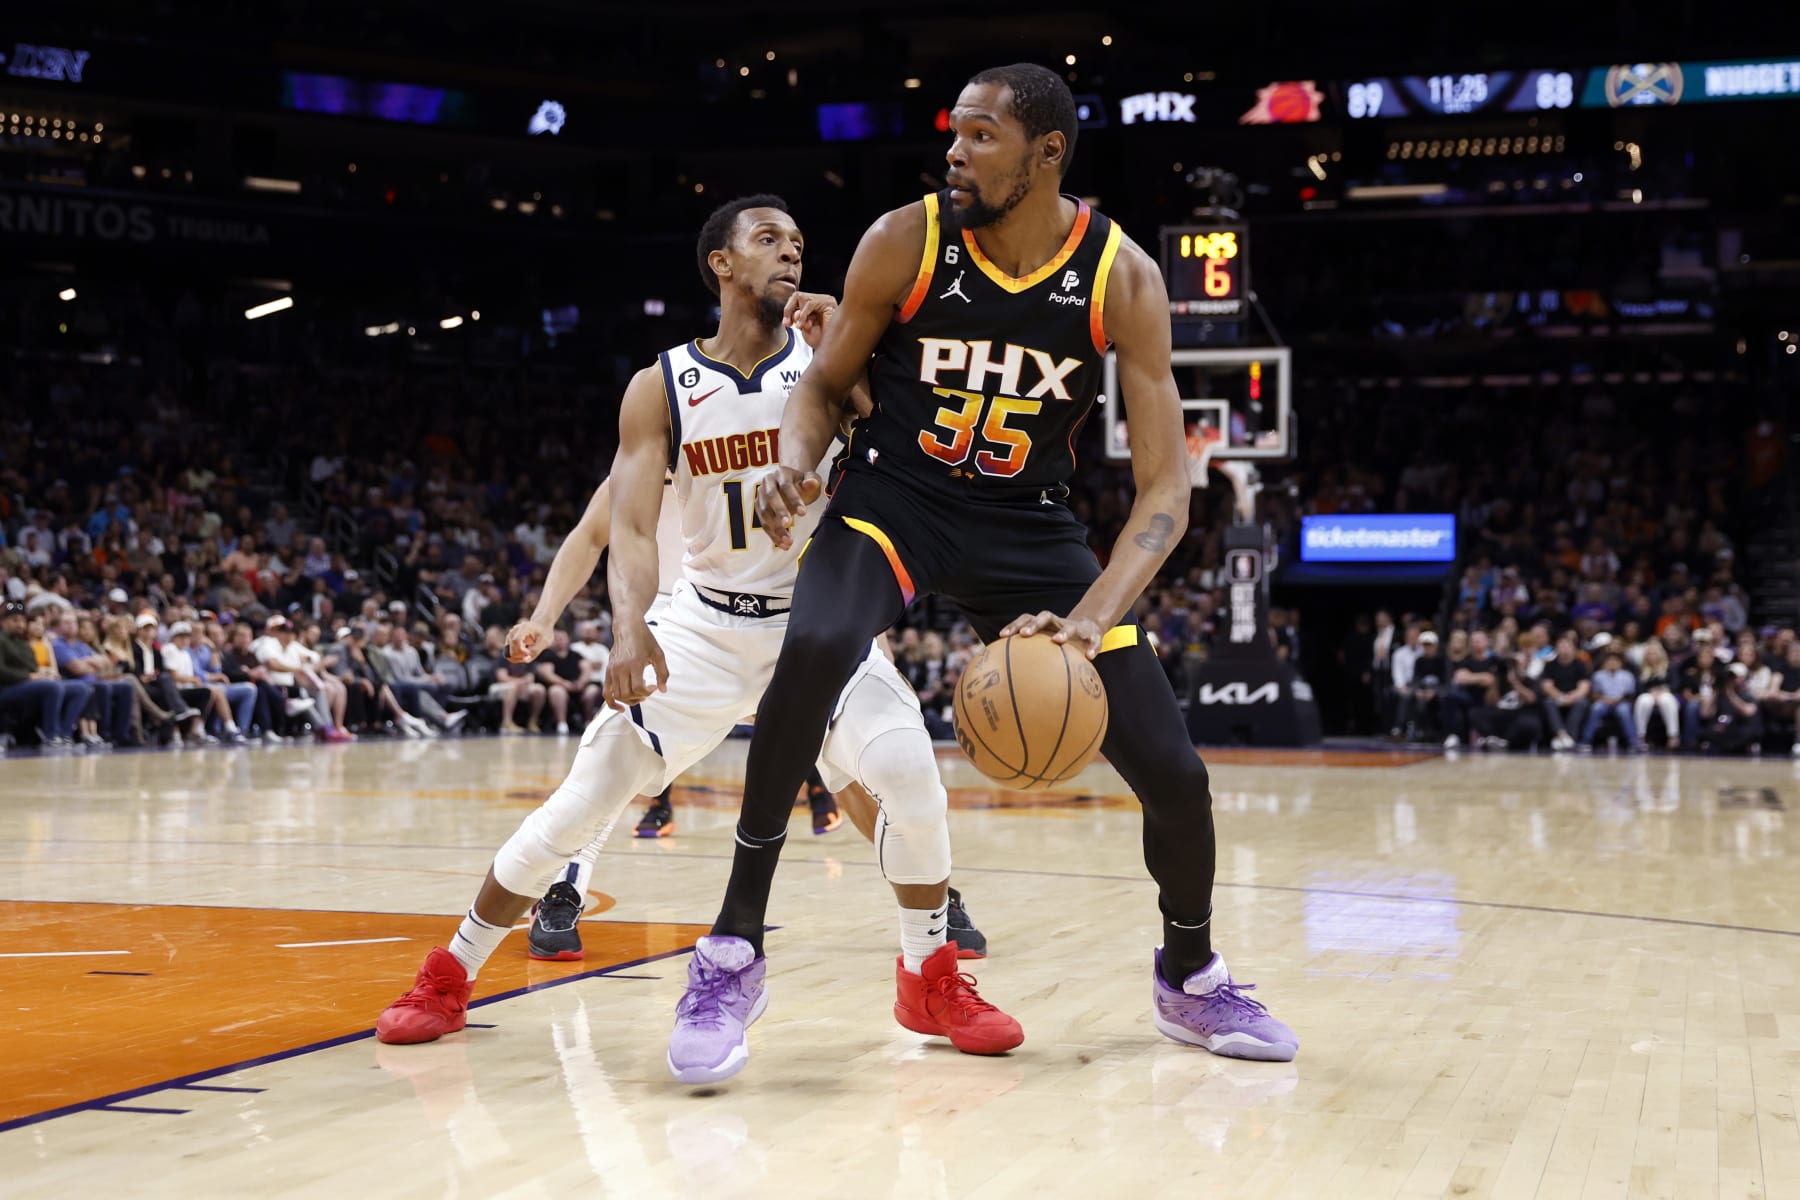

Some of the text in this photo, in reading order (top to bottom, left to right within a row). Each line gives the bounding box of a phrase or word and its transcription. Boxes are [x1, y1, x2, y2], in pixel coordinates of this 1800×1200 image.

[1348, 82, 1383, 118] 89
[1427, 73, 1488, 104] 11:25
[1120, 91, 1197, 125] PHX
[945, 245, 960, 264] 6
[1204, 257, 1232, 297] 6
[1049, 292, 1086, 307] PayPal
[683, 369, 698, 387] 6
[917, 338, 1084, 400] PHX
[918, 387, 1042, 478] 35
[1306, 526, 1442, 549] ticketmaster
